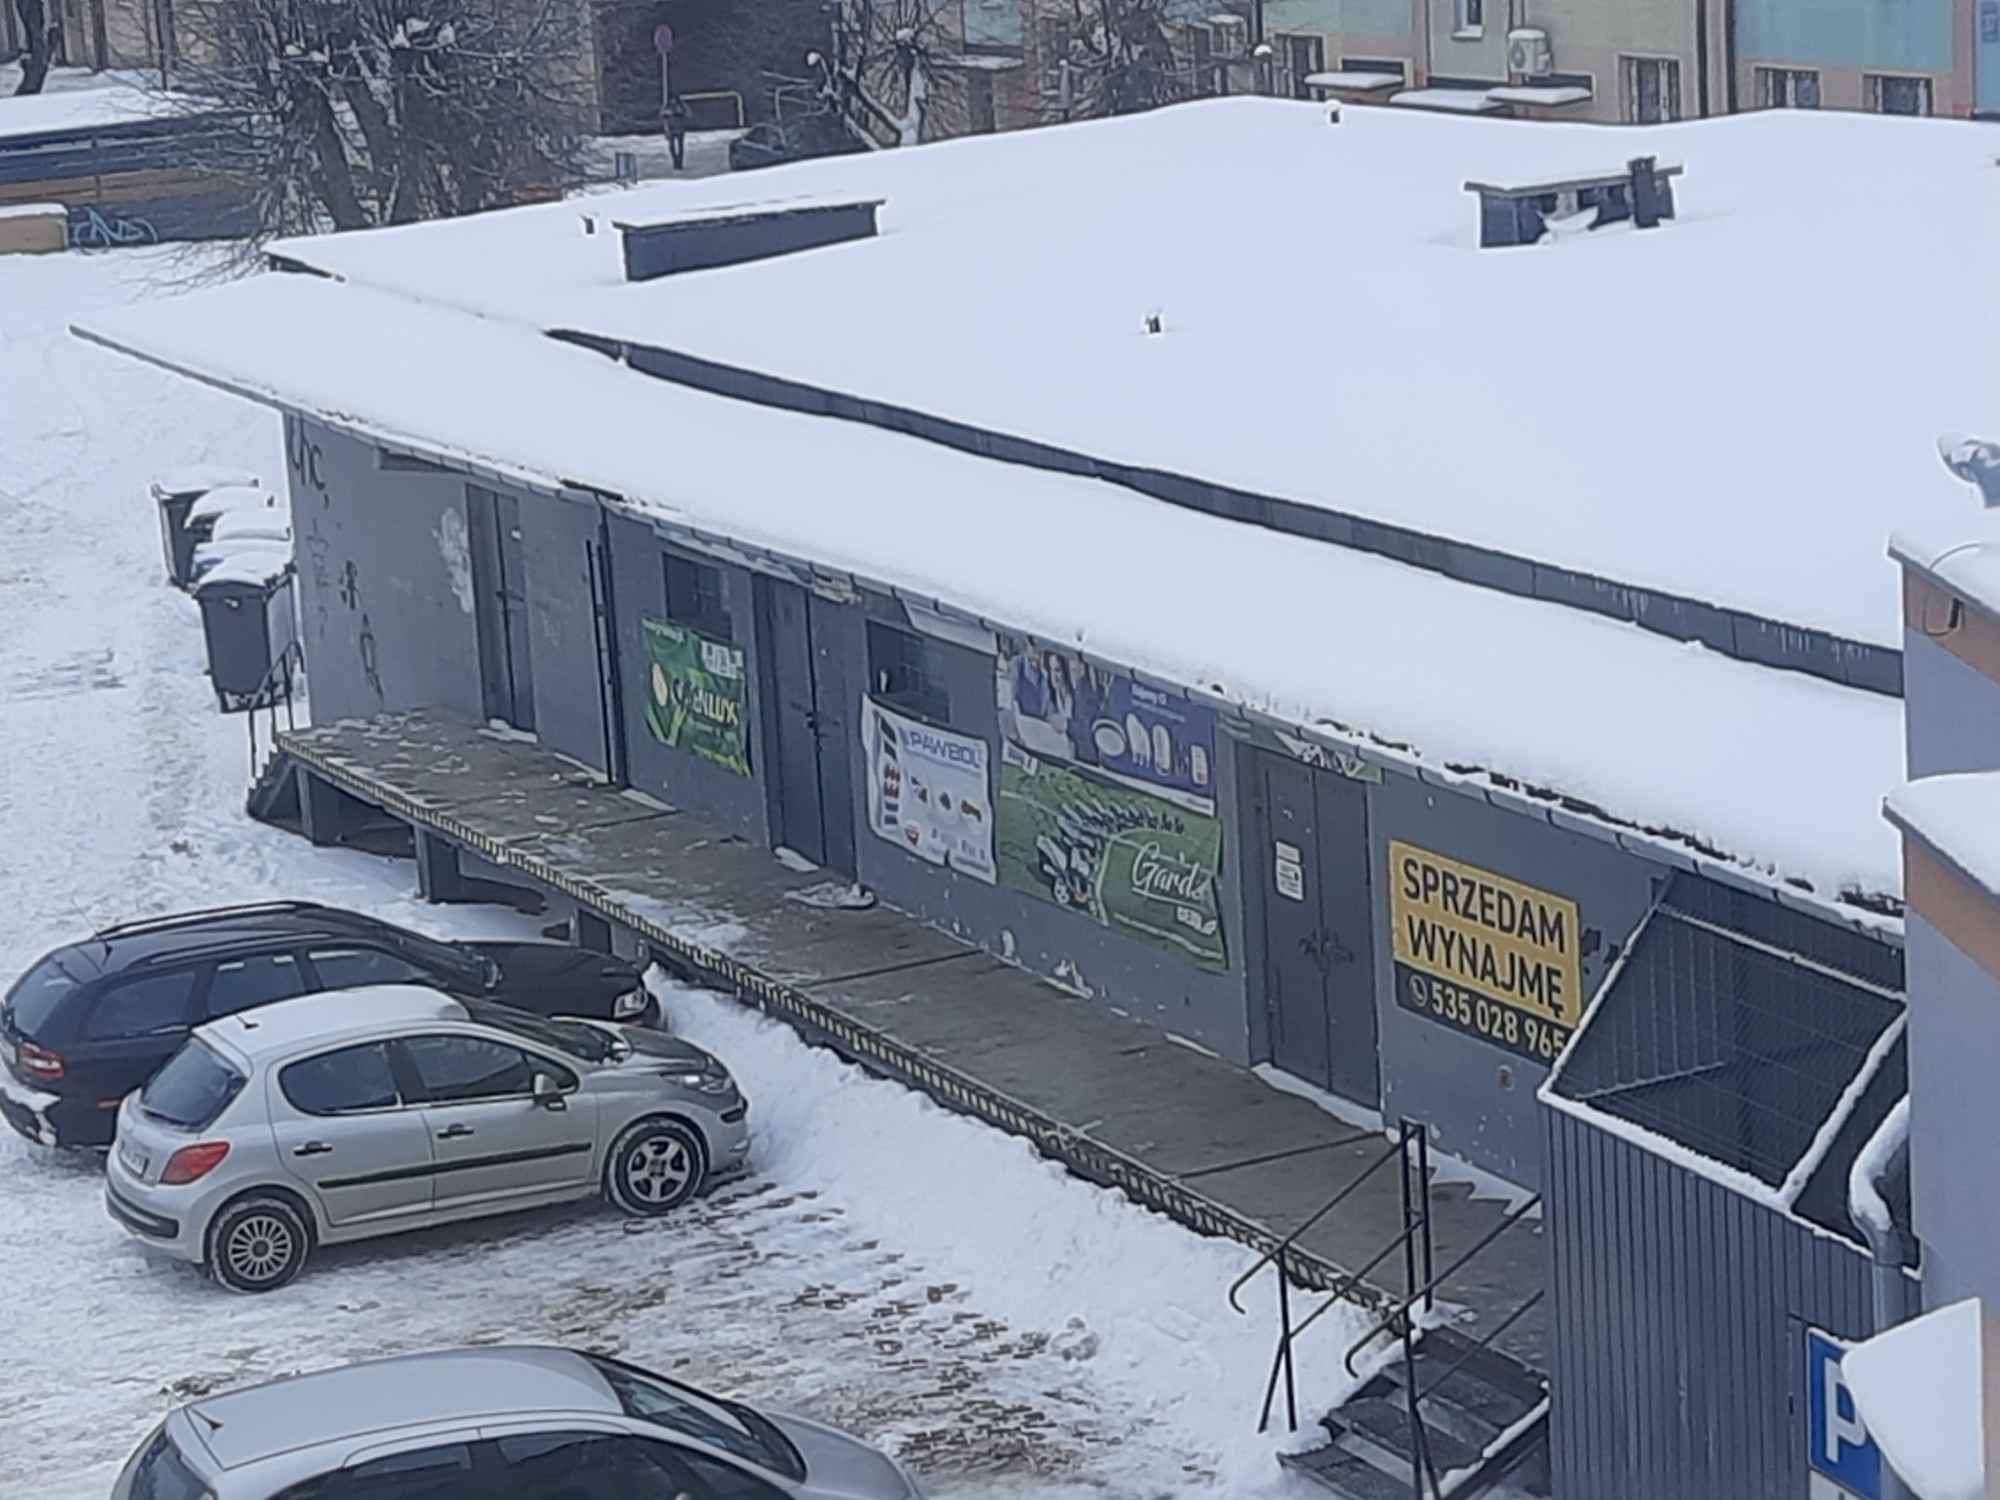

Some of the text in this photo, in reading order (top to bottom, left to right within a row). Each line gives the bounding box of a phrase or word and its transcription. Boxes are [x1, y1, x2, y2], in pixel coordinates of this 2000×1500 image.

[1403, 857, 1565, 954] SPRZEDAM
[1407, 914, 1565, 1019] WYNAJMĘ
[1431, 980, 1472, 1026] 535
[1476, 1000, 1519, 1045] 028
[1824, 1356, 1867, 1464] P
